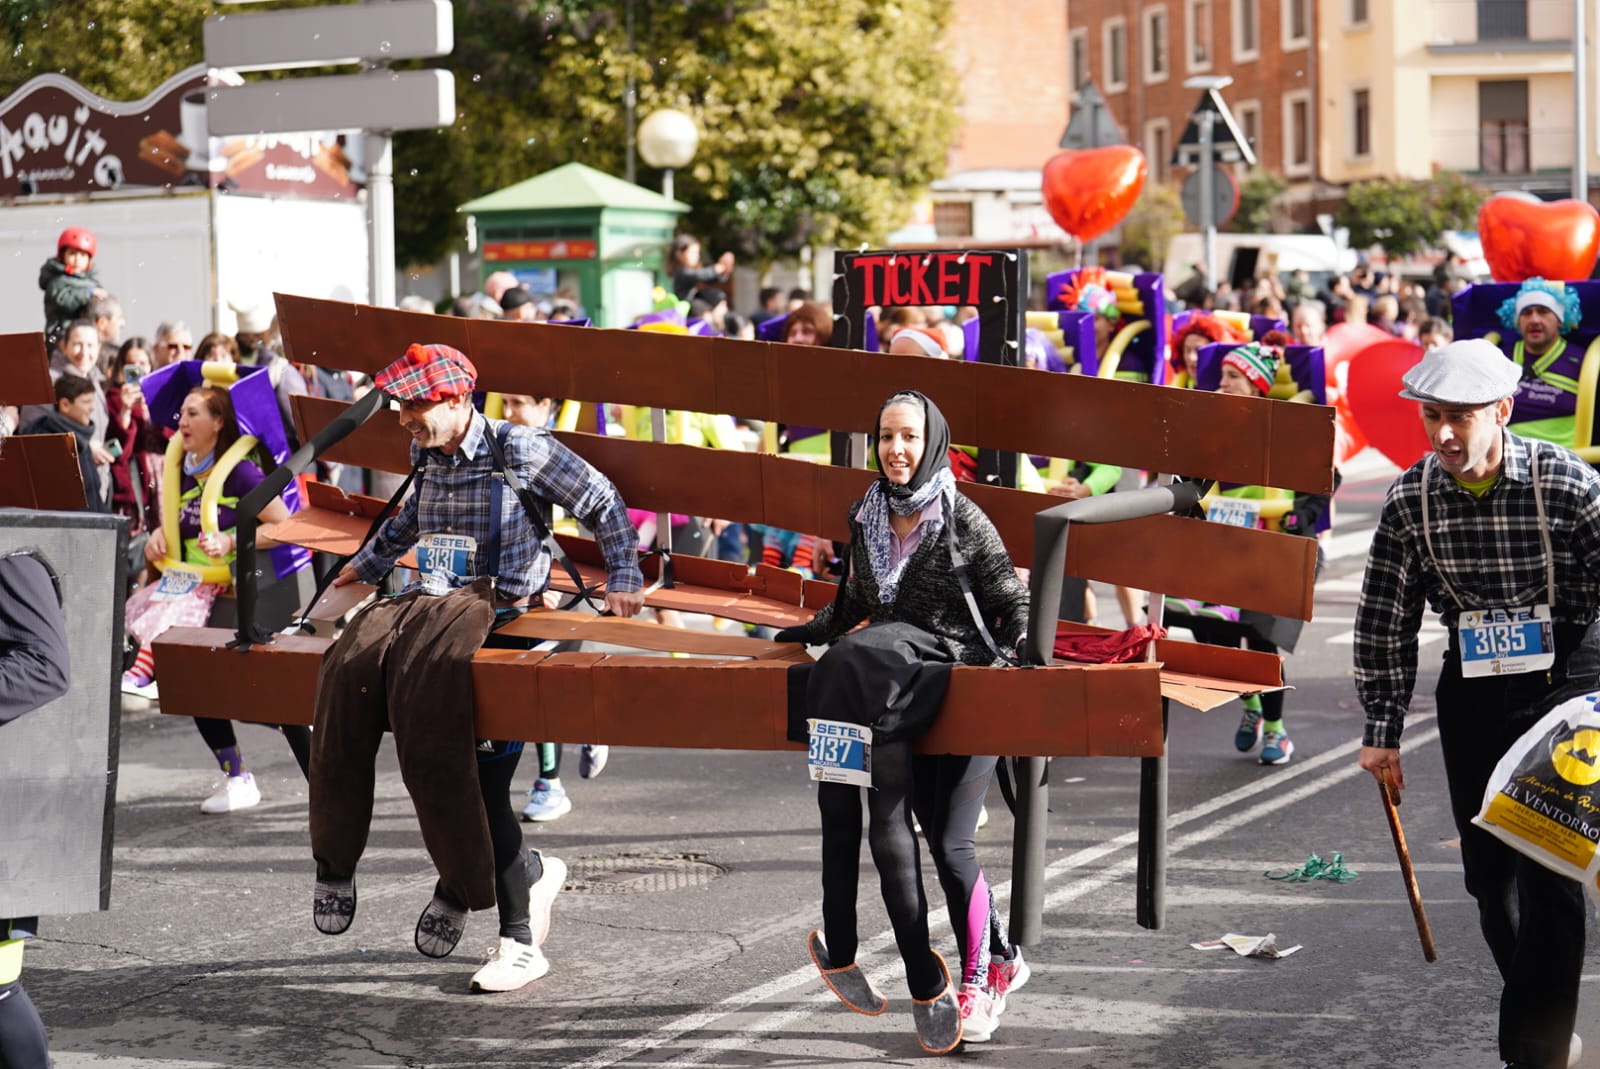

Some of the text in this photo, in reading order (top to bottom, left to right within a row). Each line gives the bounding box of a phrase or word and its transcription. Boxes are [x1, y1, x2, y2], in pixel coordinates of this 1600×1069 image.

[853, 253, 993, 307] TICKET
[432, 538, 470, 548] SETEL
[426, 548, 455, 572] 3131
[1474, 625, 1526, 655] 3135
[817, 723, 865, 740] SETEL
[808, 735, 852, 763] 3137
[1505, 782, 1519, 799] EL
[1525, 790, 1599, 840] VENTORRO
